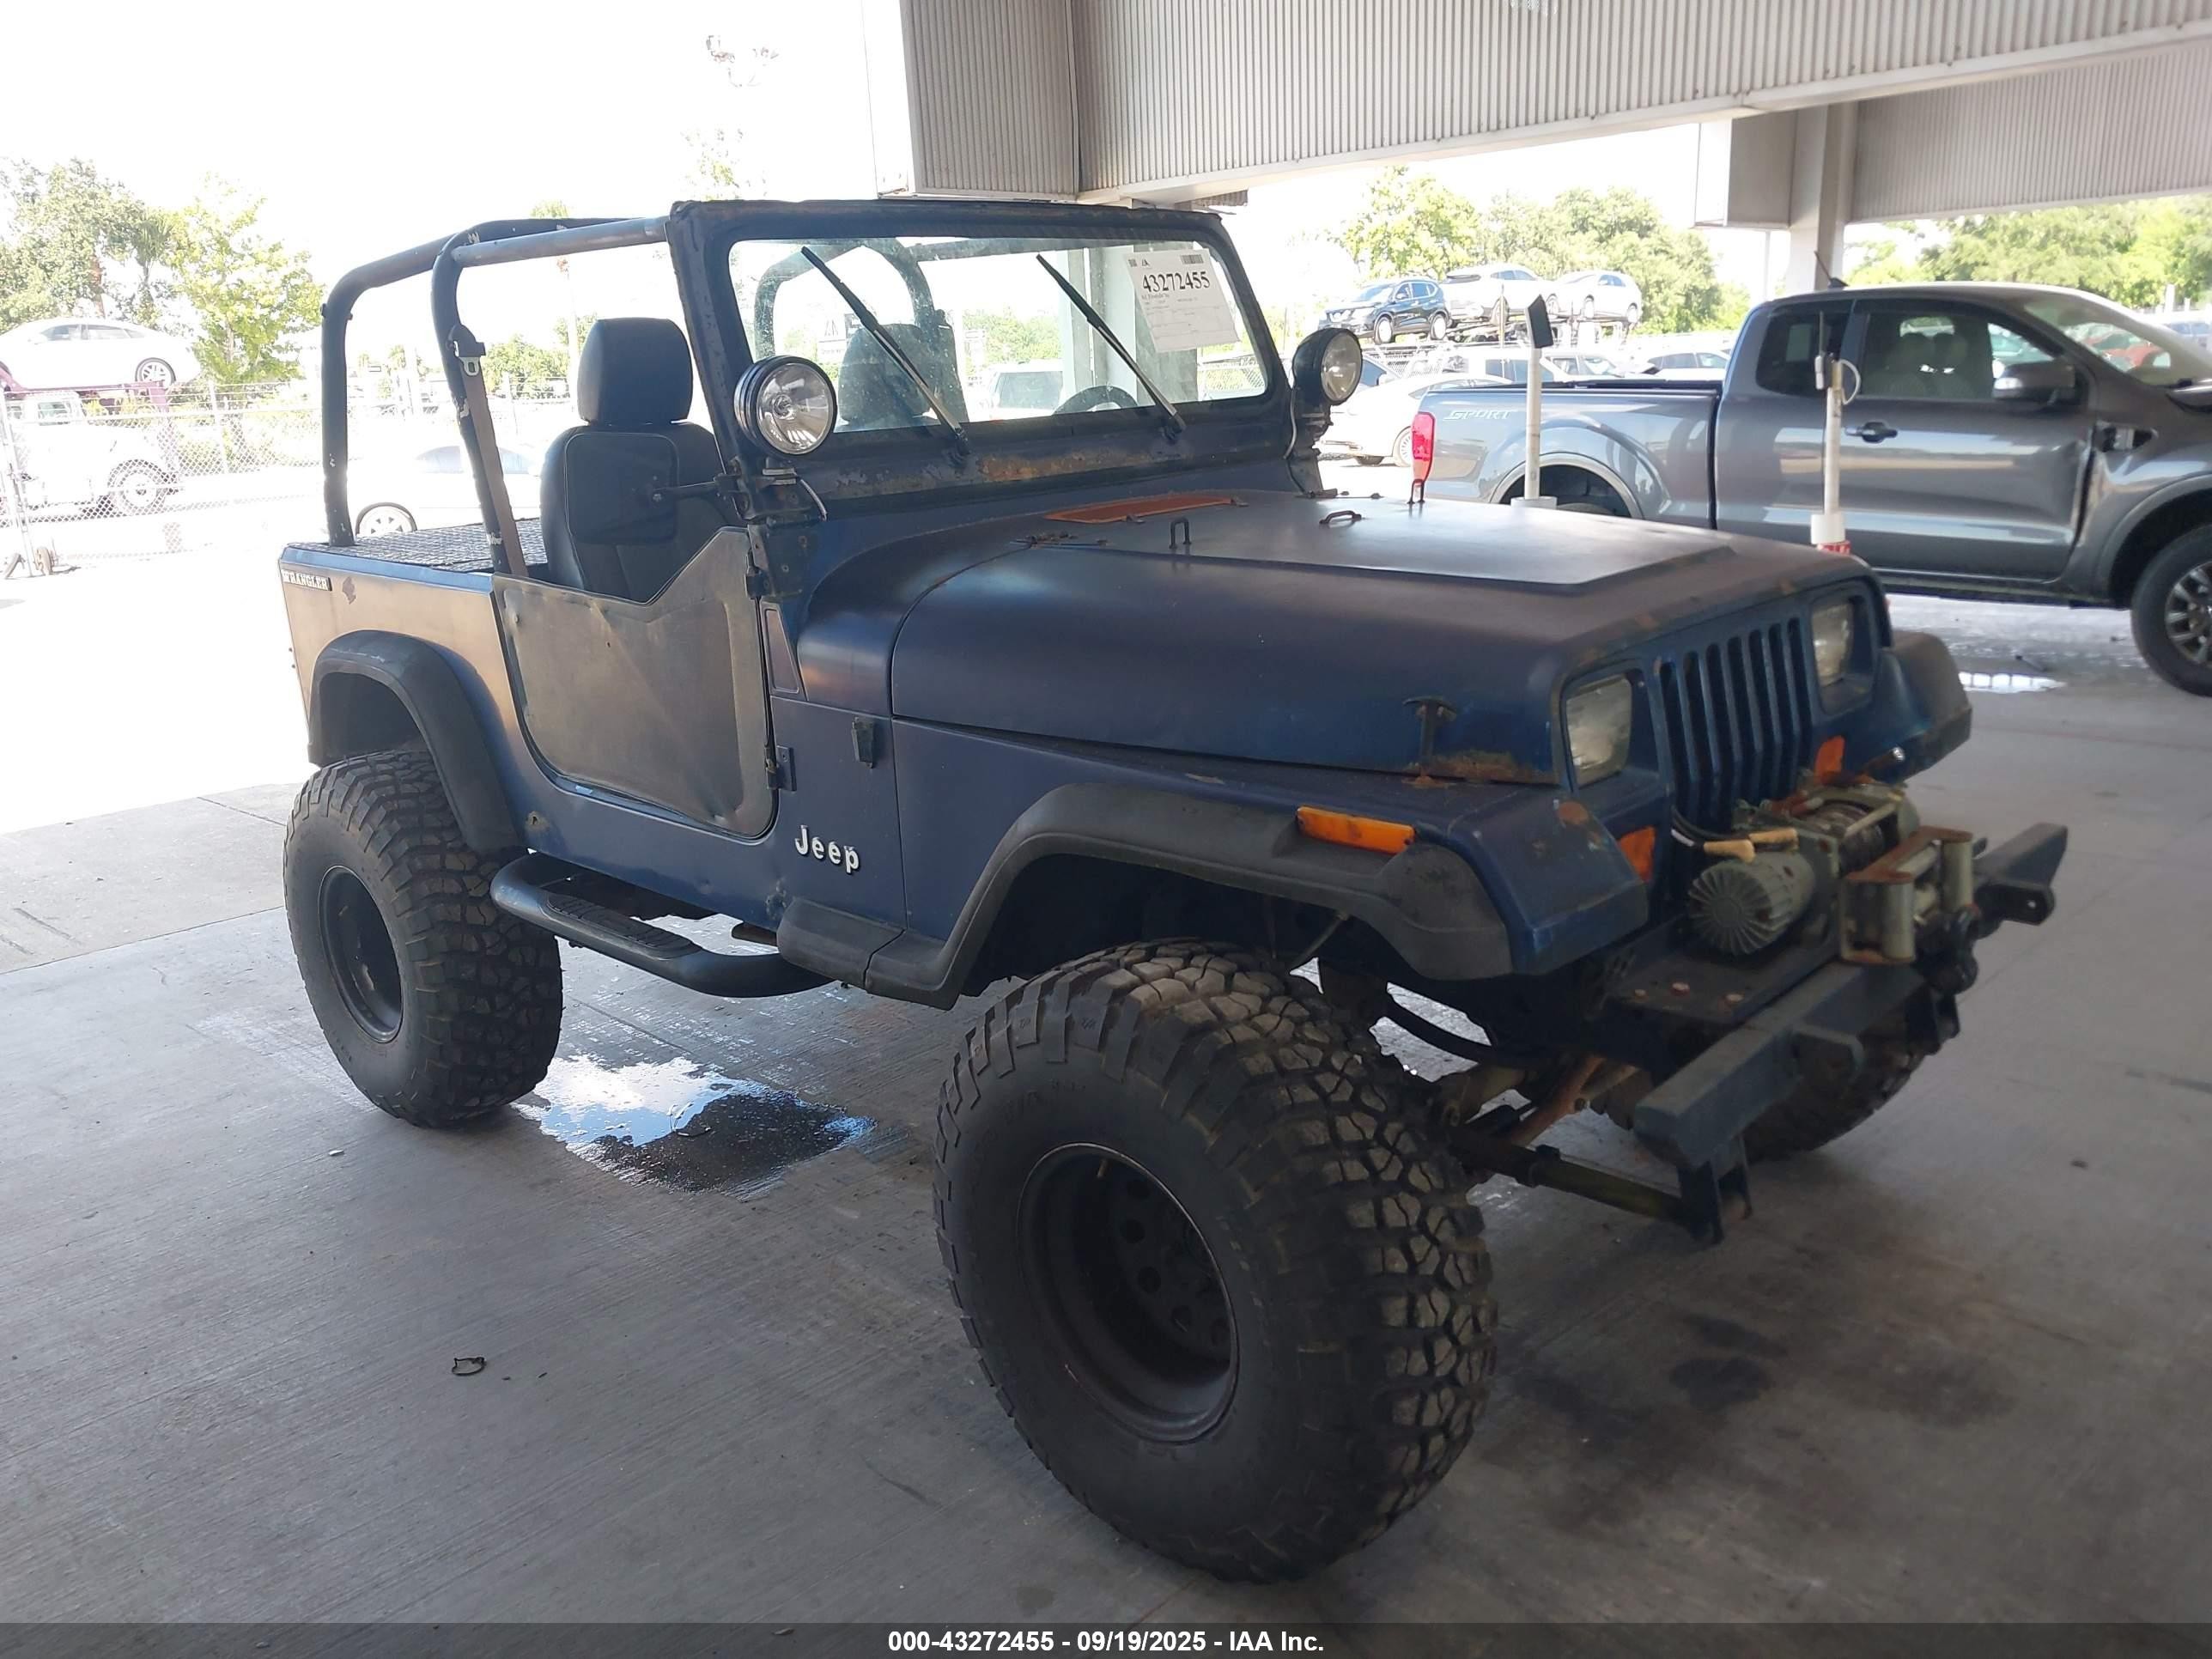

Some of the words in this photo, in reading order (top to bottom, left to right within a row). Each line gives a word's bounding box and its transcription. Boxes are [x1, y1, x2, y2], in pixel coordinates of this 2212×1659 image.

[1142, 270, 1211, 293] 43272455
[1443, 410, 1517, 421] SPORT
[281, 568, 329, 591] WRANGLER
[794, 824, 860, 874] Jeep
